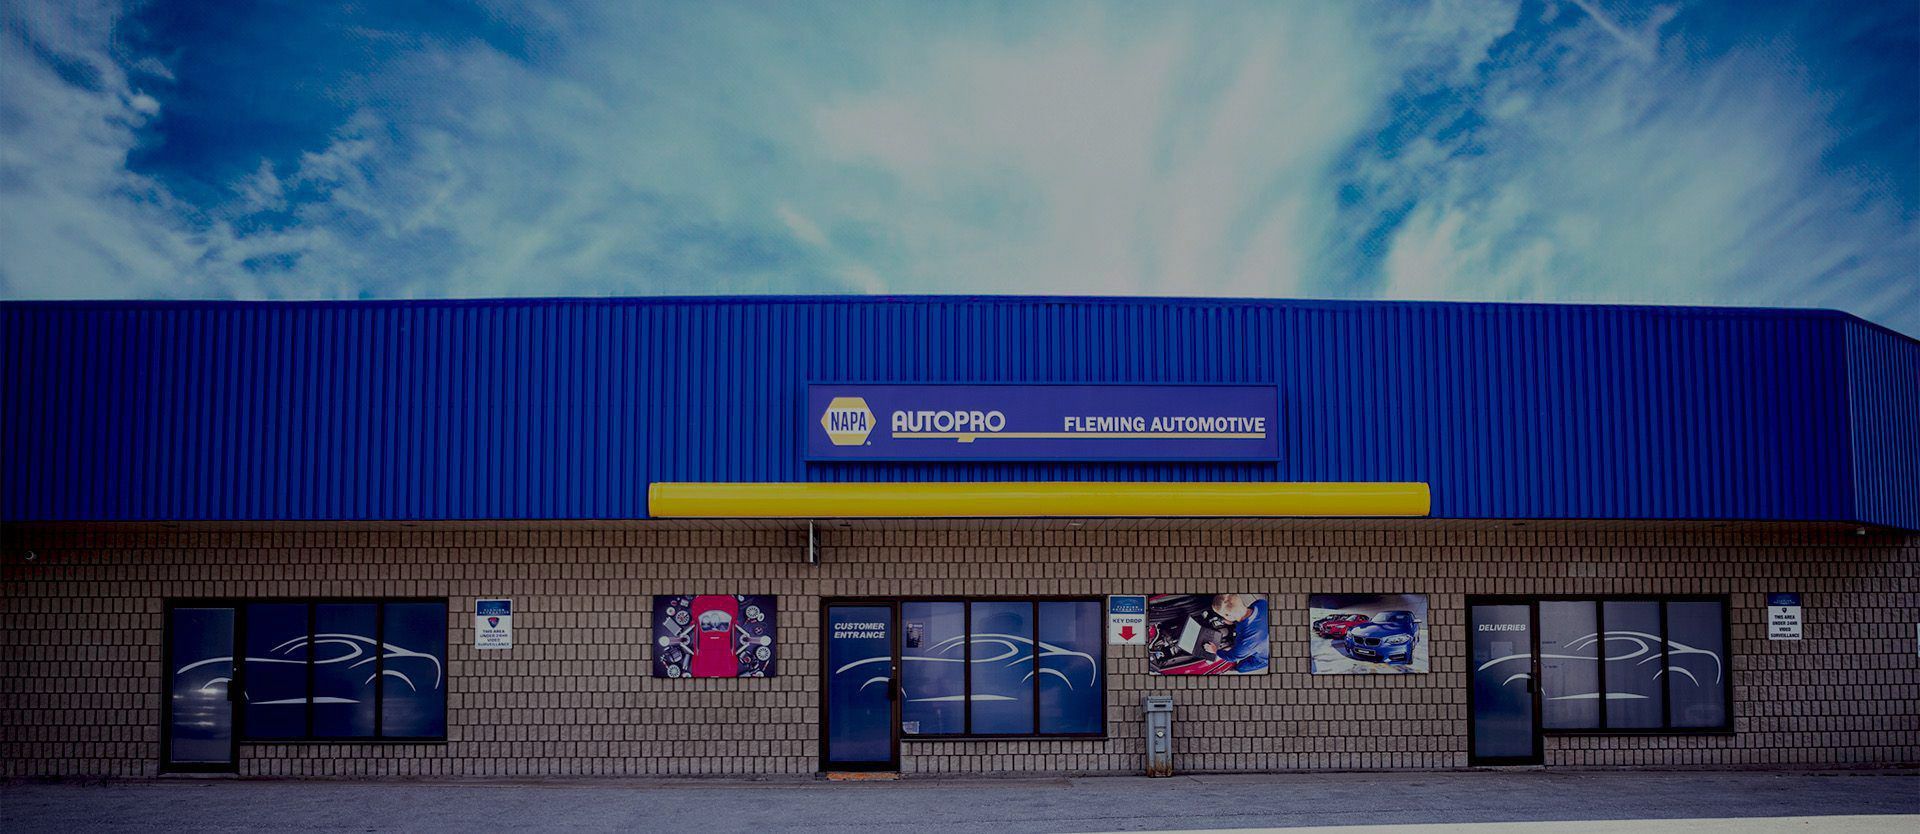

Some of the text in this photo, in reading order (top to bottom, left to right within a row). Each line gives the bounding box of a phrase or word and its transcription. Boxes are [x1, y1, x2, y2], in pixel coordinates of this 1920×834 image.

[830, 411, 867, 431] NAPA
[892, 410, 1006, 432] AUTOPRO
[1064, 416, 1266, 432] FLEMING AUTOMOTIVE
